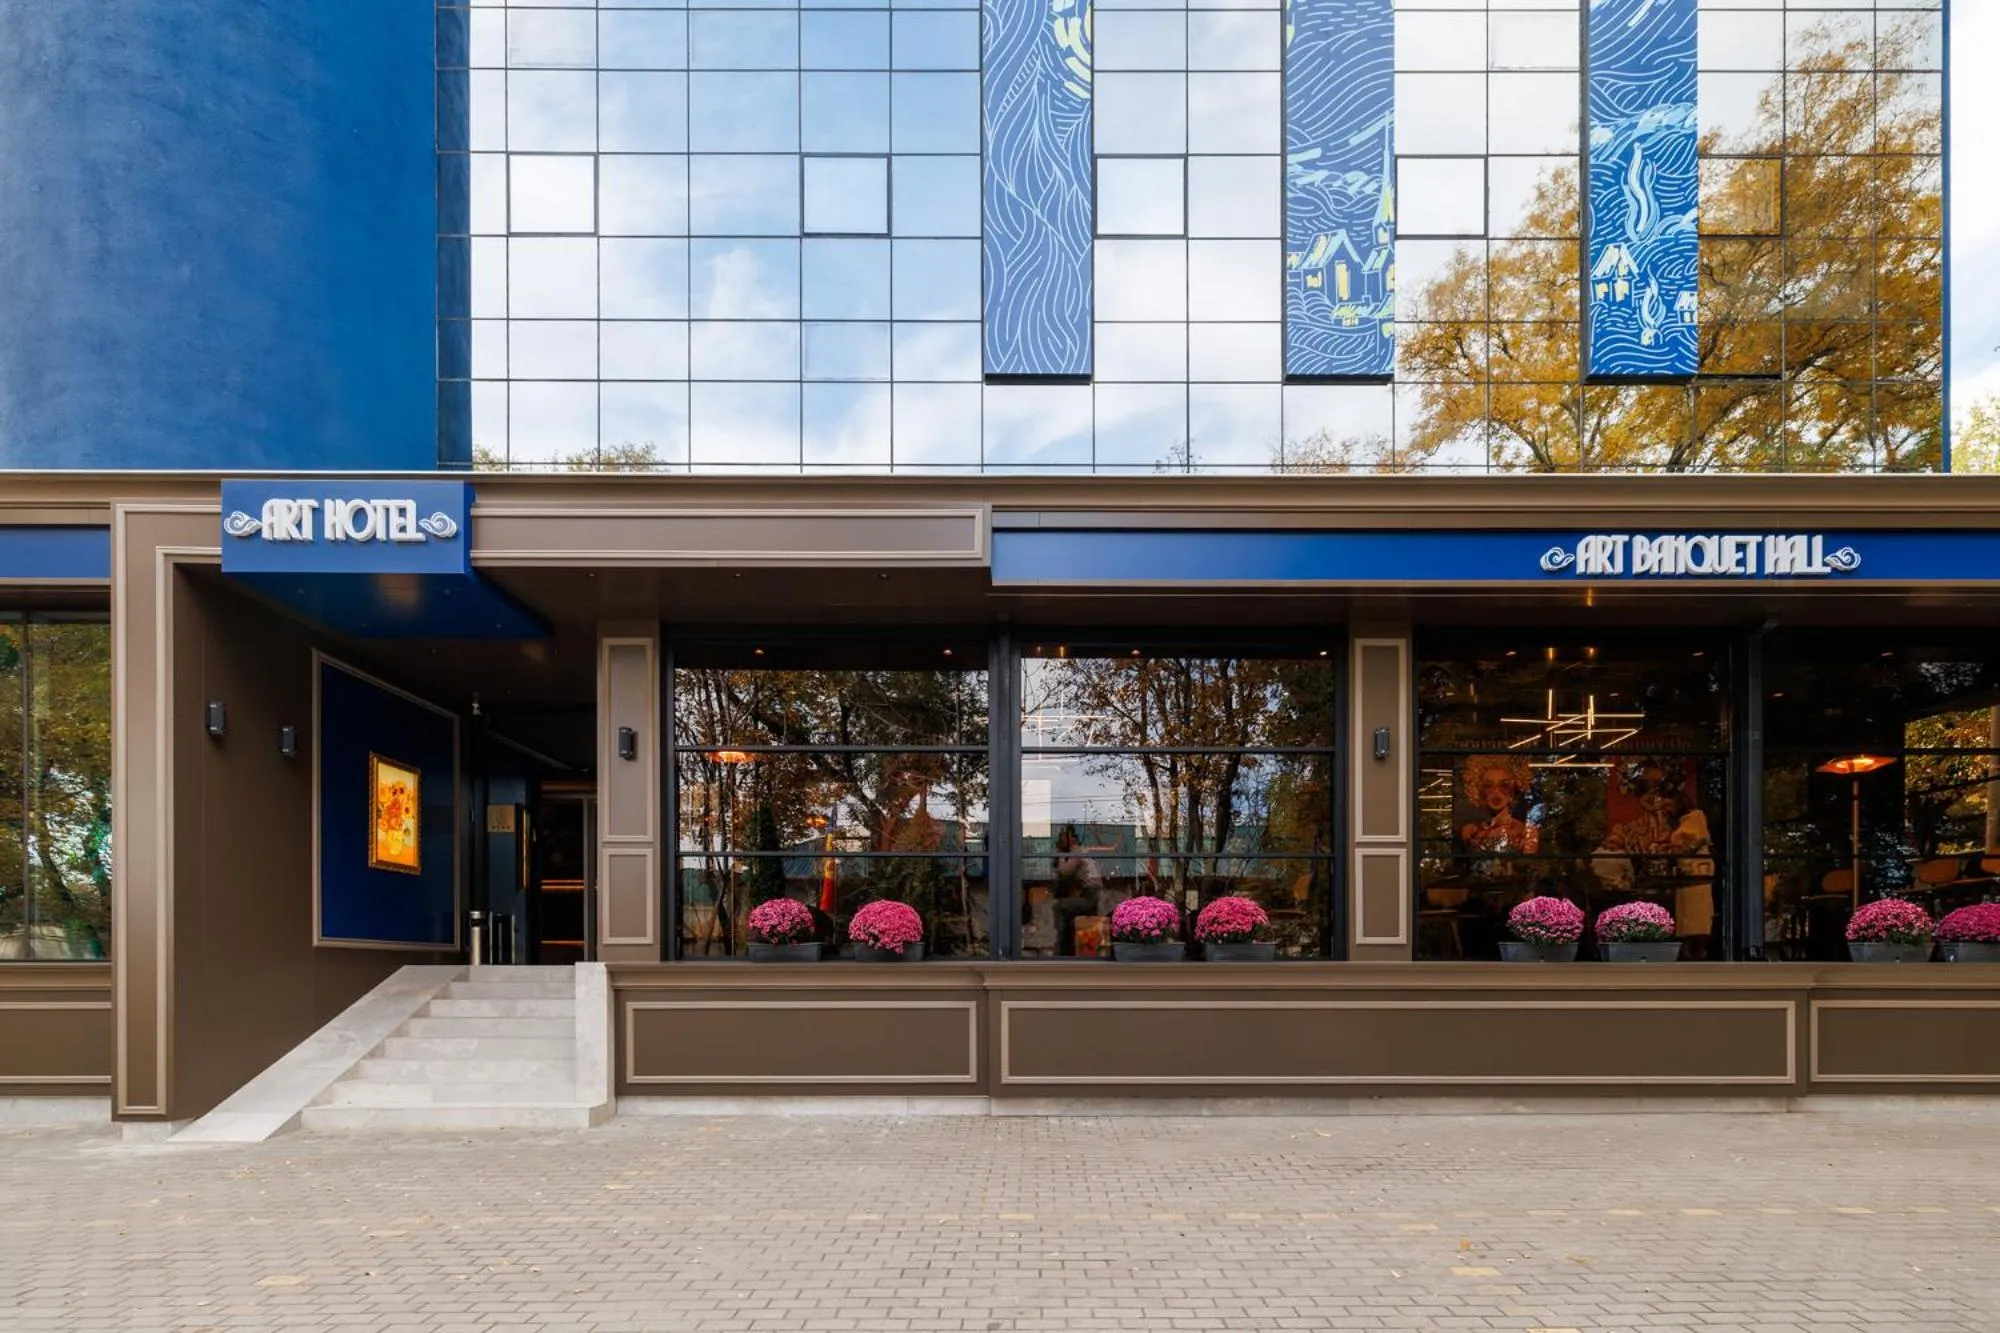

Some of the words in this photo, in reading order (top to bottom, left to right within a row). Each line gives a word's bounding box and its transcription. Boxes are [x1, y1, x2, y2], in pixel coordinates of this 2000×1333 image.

[261, 498, 319, 541] ART
[324, 498, 427, 542] HOTEL
[1576, 535, 1629, 575] ART
[1632, 535, 1762, 575] BANQUET
[1764, 535, 1832, 575] HALL
